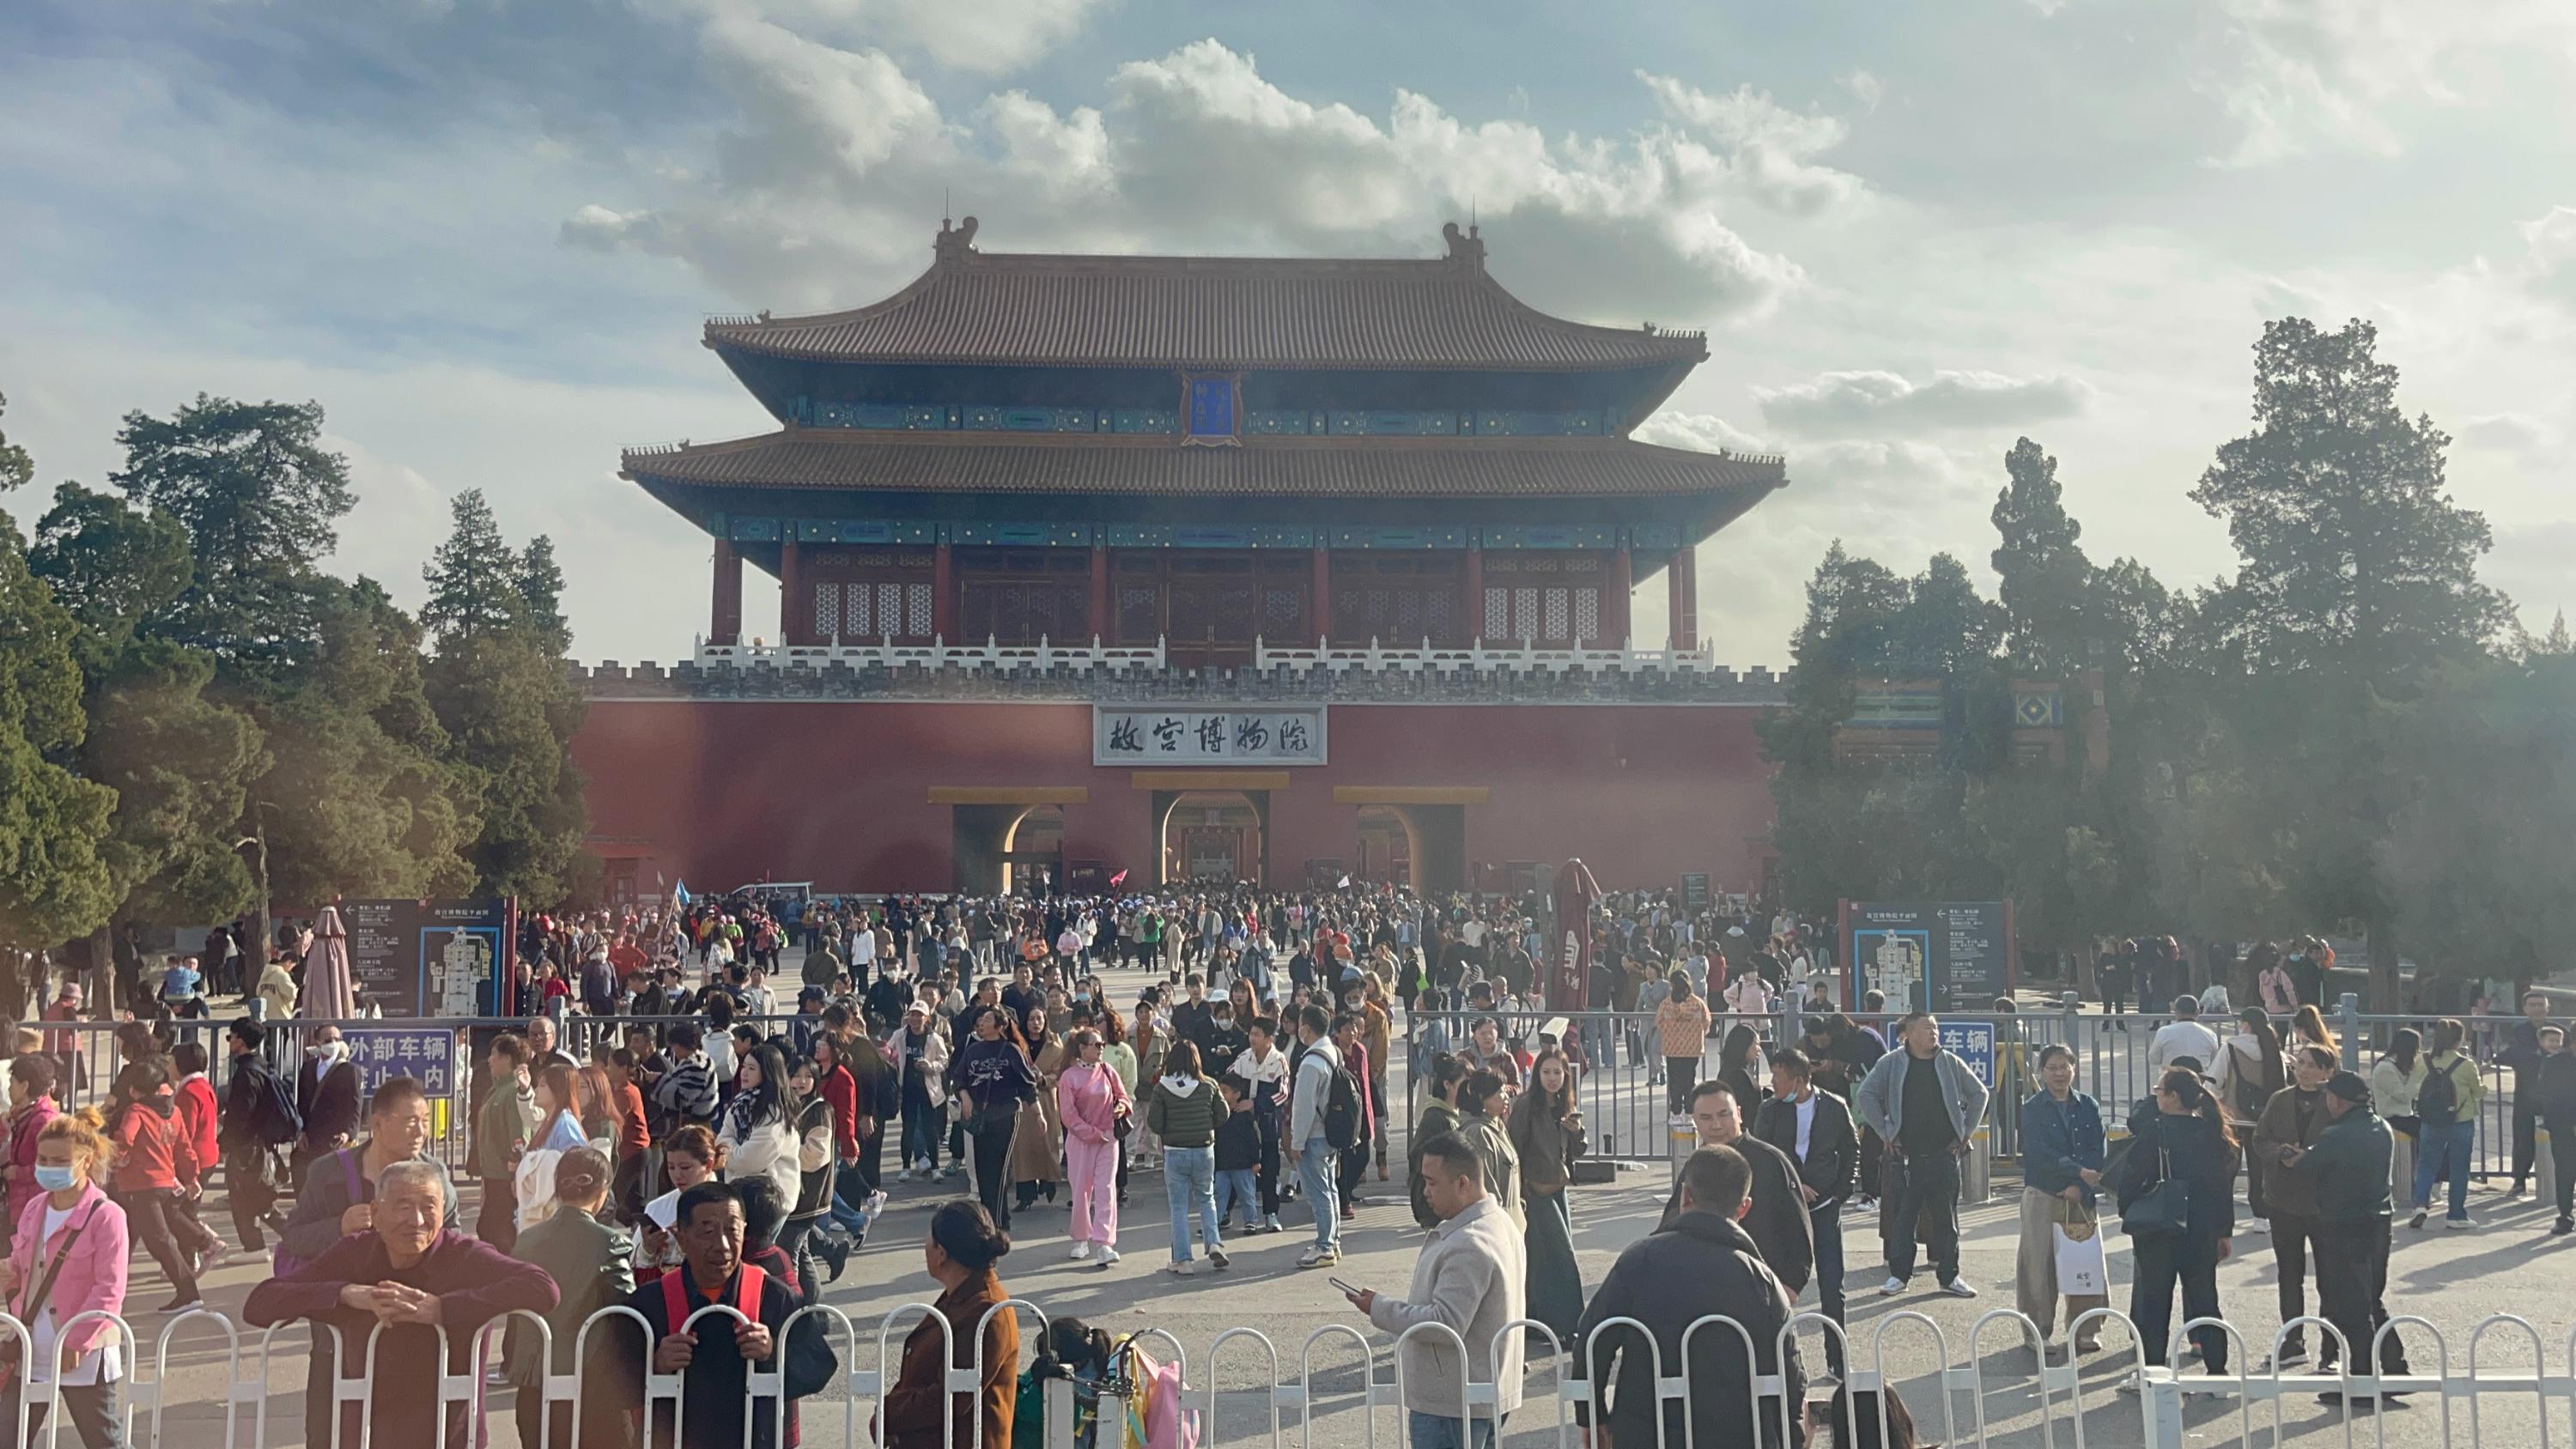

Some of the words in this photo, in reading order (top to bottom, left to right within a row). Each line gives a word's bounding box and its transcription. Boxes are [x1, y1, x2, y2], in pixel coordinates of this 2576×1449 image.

[1109, 716, 1309, 753] 故宫博物院
[349, 1036, 447, 1061] 外部车辆
[1943, 1029, 1989, 1053] 车辆
